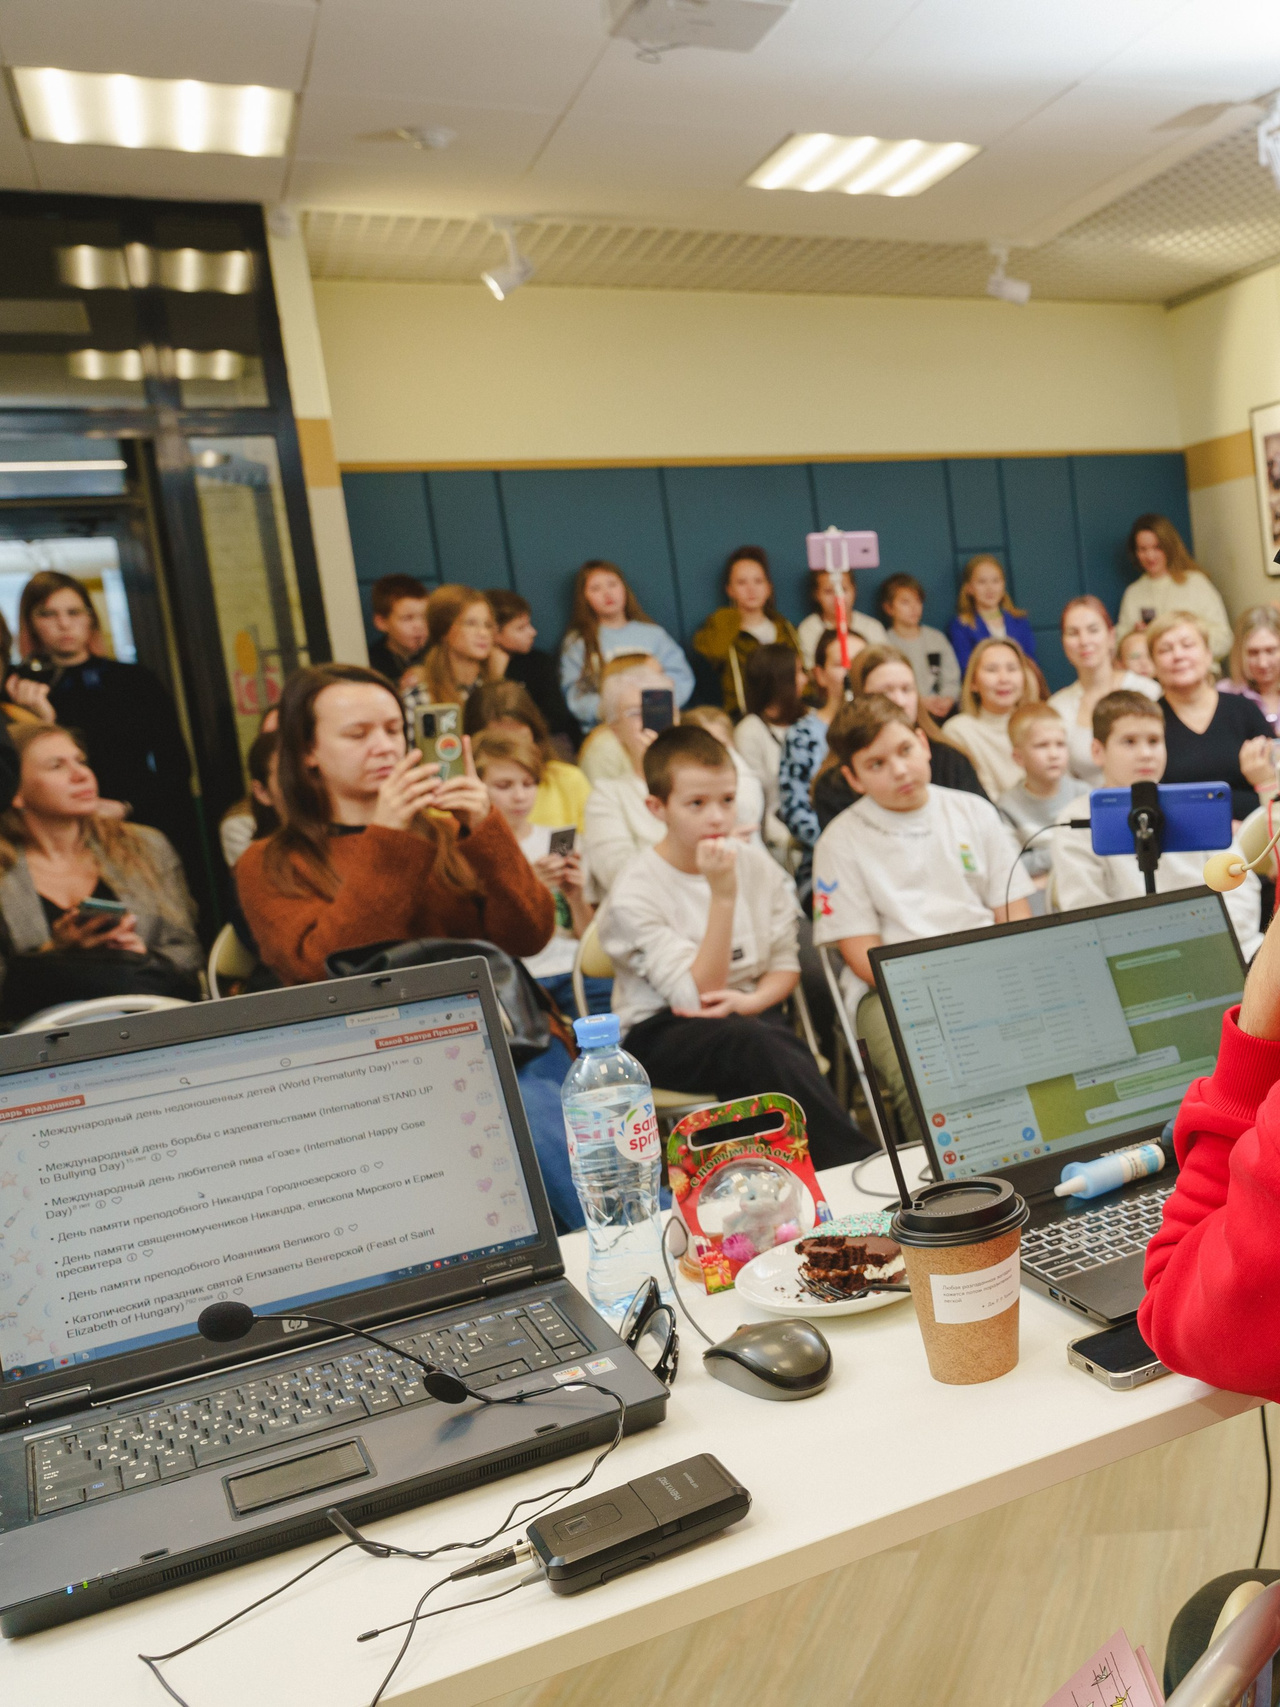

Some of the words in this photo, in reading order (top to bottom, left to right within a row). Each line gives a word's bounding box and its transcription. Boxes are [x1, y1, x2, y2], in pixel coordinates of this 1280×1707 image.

[378, 1038, 402, 1048] Какой
[404, 1032, 432, 1044] Завтра
[433, 1024, 475, 1037] Праздник?
[24, 1098, 81, 1115] праздников
[39, 1112, 133, 1138] Международный
[135, 1107, 162, 1122] день
[164, 1091, 244, 1115] недоношенных
[246, 1084, 277, 1100] детей
[278, 1076, 311, 1094] (World
[312, 1064, 367, 1084] Prematurity
[369, 1060, 392, 1075] Day)
[45, 1146, 139, 1172] Международный
[141, 1141, 169, 1156] день
[170, 1131, 213, 1147] борьбы
[223, 1111, 317, 1137] издевательствами
[319, 1096, 382, 1117] (International
[383, 1089, 417, 1103] STAND
[420, 1086, 434, 1096] UP
[40, 1176, 50, 1185] to
[53, 1167, 97, 1185] Bullying
[99, 1160, 125, 1174] Day)
[51, 1180, 146, 1207] Международный
[148, 1174, 175, 1189] день
[177, 1160, 238, 1181] любителей
[239, 1154, 264, 1167] пива
[266, 1148, 301, 1162] «Гозе»
[303, 1132, 367, 1154] (International
[368, 1125, 399, 1140] Happy
[400, 1119, 426, 1131] Gose
[698, 1147, 745, 1178] НОВЫМ
[746, 1145, 795, 1164] ГОДОМ!
[45, 1206, 73, 1221] Day)
[57, 1229, 87, 1244] День
[89, 1219, 131, 1235] памяти
[133, 1201, 210, 1227] преподобного
[211, 1188, 264, 1207] Никандра
[266, 1167, 357, 1195] Городноезерского
[61, 1252, 91, 1267] День
[93, 1242, 135, 1258] памяти
[138, 1215, 249, 1250] священномучеников
[250, 1203, 306, 1222] Никандра,
[307, 1192, 354, 1209] епископа
[356, 1179, 403, 1197] Мирского
[404, 1178, 411, 1186] и
[413, 1170, 445, 1184] Ермея
[56, 1258, 123, 1279] пресвитера
[67, 1288, 98, 1303] День
[100, 1277, 141, 1294] памяти
[144, 1258, 221, 1283] преподобного
[222, 1243, 281, 1264] Иоанникия
[282, 1231, 331, 1249] Великого
[72, 1298, 152, 1325] Католический
[153, 1286, 205, 1305] праздник
[206, 1275, 245, 1292] святой
[246, 1261, 304, 1283] Елизаветы
[306, 1245, 365, 1267] Венгерской
[366, 1237, 397, 1254] (Feast
[399, 1234, 410, 1244] of
[410, 1228, 436, 1240] Saint
[66, 1320, 119, 1339] Elizabeth
[121, 1316, 133, 1330] of
[135, 1303, 185, 1325] Hungary)
